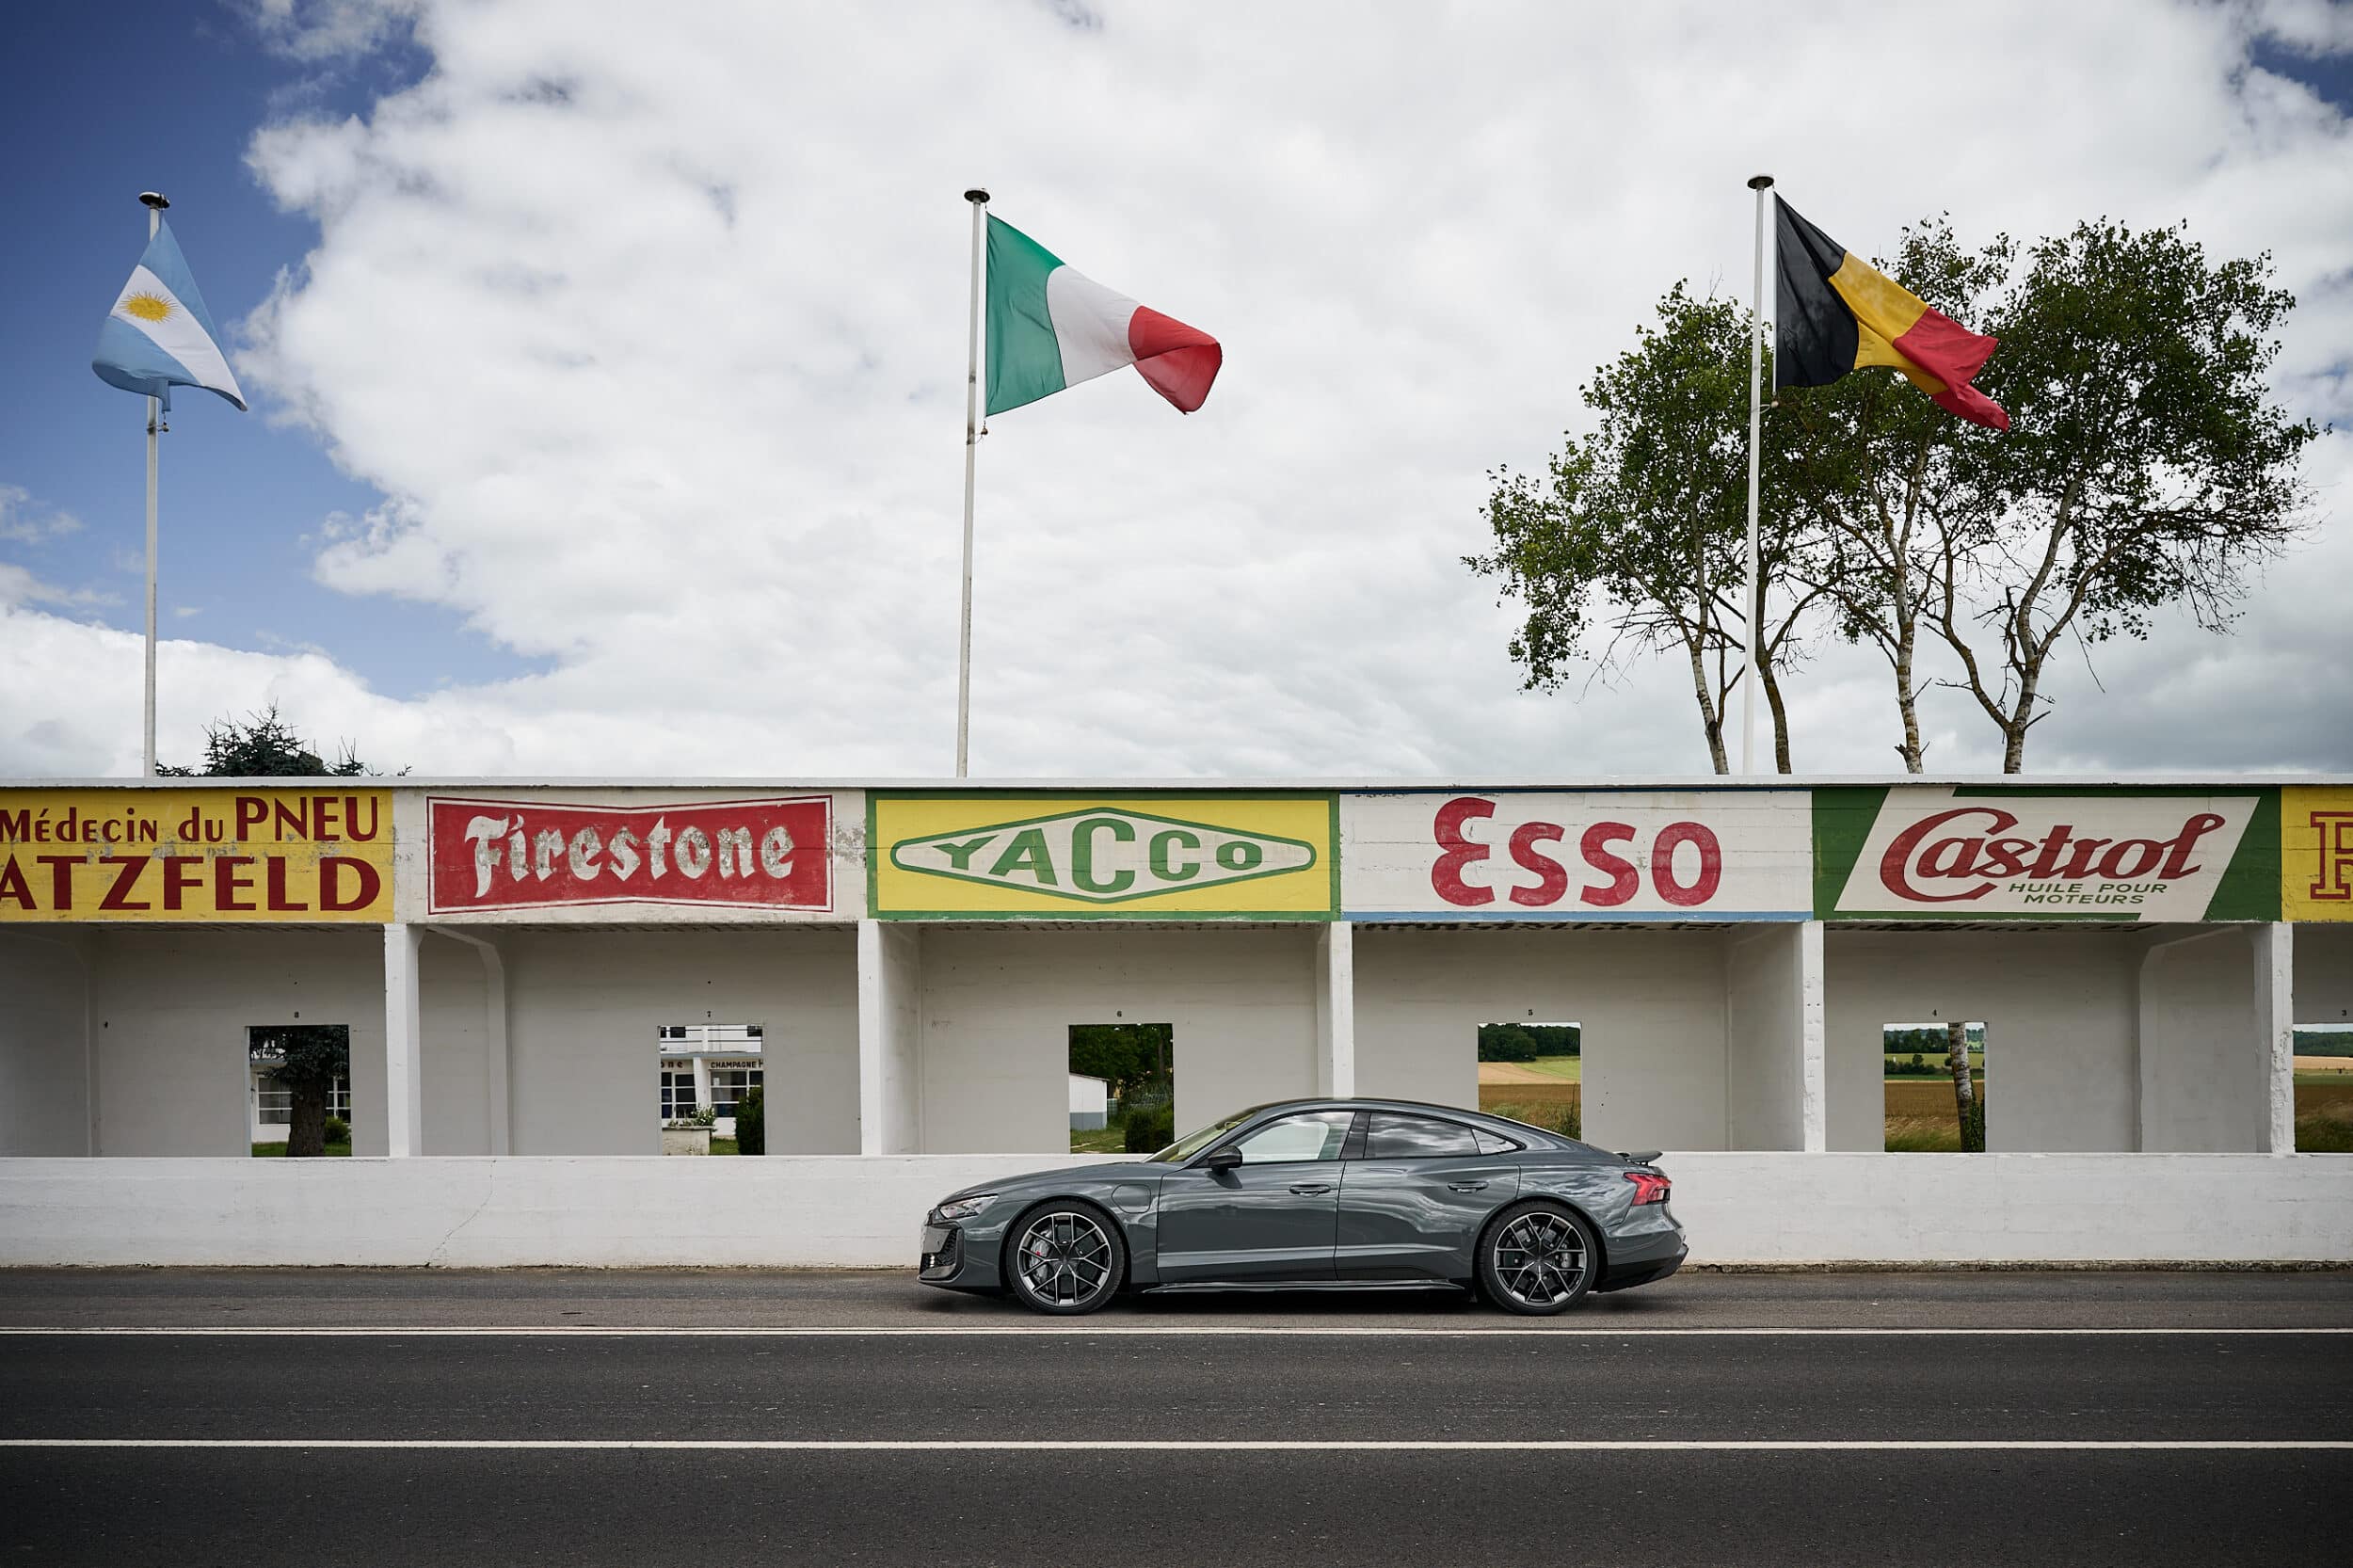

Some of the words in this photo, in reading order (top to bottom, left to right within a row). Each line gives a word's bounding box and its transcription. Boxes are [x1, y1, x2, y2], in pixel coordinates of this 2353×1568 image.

[179, 807, 224, 842] du
[235, 796, 377, 842] PNEU
[0, 852, 381, 911] ATZFELD
[464, 813, 794, 898] Firestone
[933, 817, 1262, 894] YACCO
[1880, 807, 2226, 903] Castrol
[2009, 883, 2084, 893] HUILE
[2098, 883, 2168, 893] POUR
[2024, 894, 2145, 904] MOTEURS
